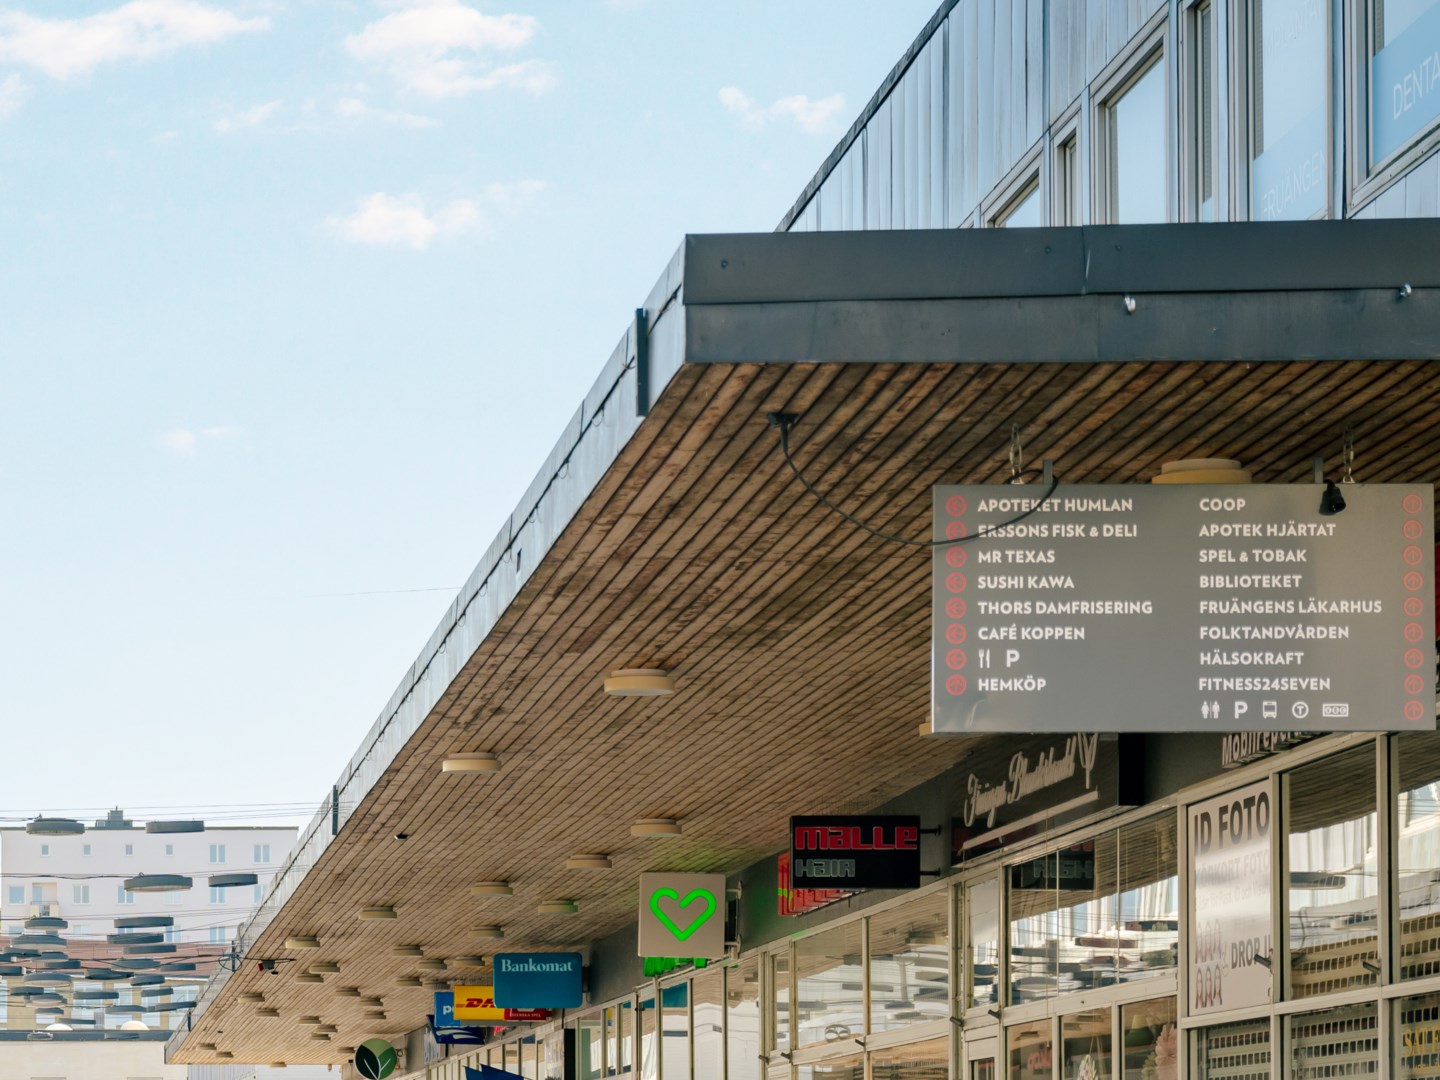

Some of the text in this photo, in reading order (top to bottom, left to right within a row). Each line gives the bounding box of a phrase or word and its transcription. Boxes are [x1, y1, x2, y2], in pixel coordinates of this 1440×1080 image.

[978, 499, 1132, 512] APOTEKET HUMLAN
[1200, 499, 1246, 511] COOP
[978, 525, 1137, 537] ERSSONS FISK & DELI
[1199, 521, 1336, 536] APOTEK HJÄRTAT
[978, 550, 1055, 563] MR TEXAS
[1200, 550, 1307, 562] SPEL & TOBAK
[978, 576, 1075, 589] SUSHI KAWA
[1200, 575, 1302, 588] BIBLIOTEKET
[978, 602, 1152, 614] THORS DAMFRISERING
[1200, 598, 1382, 614] FRUÄNGENS LÄKARHUS
[978, 624, 1085, 640] CAFÉ KOPPEN
[1200, 624, 1349, 639] FOLKTANDVÅRDEN
[1200, 649, 1304, 665] HÄLSOKRAFT
[978, 675, 1046, 691] HEMKÖP
[1199, 678, 1330, 691] FITNESS24SEVEN
[1194, 791, 1270, 856] ID FOTO
[1231, 937, 1260, 969] DROP
[501, 958, 573, 972] Bankomat
[465, 998, 494, 1008] DH
